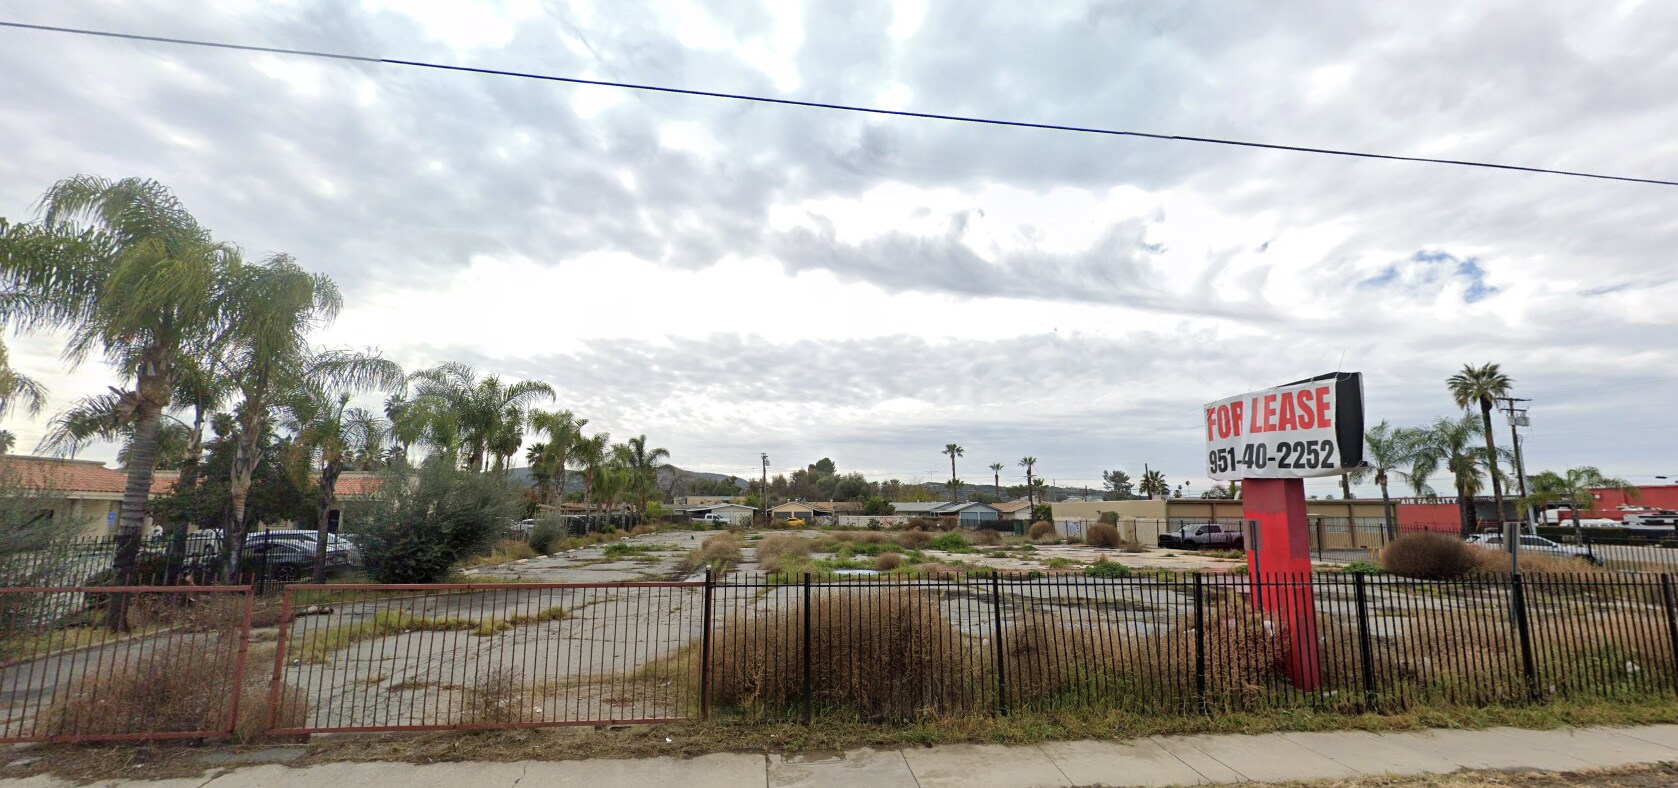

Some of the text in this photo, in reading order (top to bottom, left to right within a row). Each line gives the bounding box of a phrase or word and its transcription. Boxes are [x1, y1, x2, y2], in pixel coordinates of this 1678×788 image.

[1206, 386, 1332, 442] FOR LEASE
[1209, 440, 1335, 474] 951-40-2252
[1417, 497, 1457, 505] FACILITY
